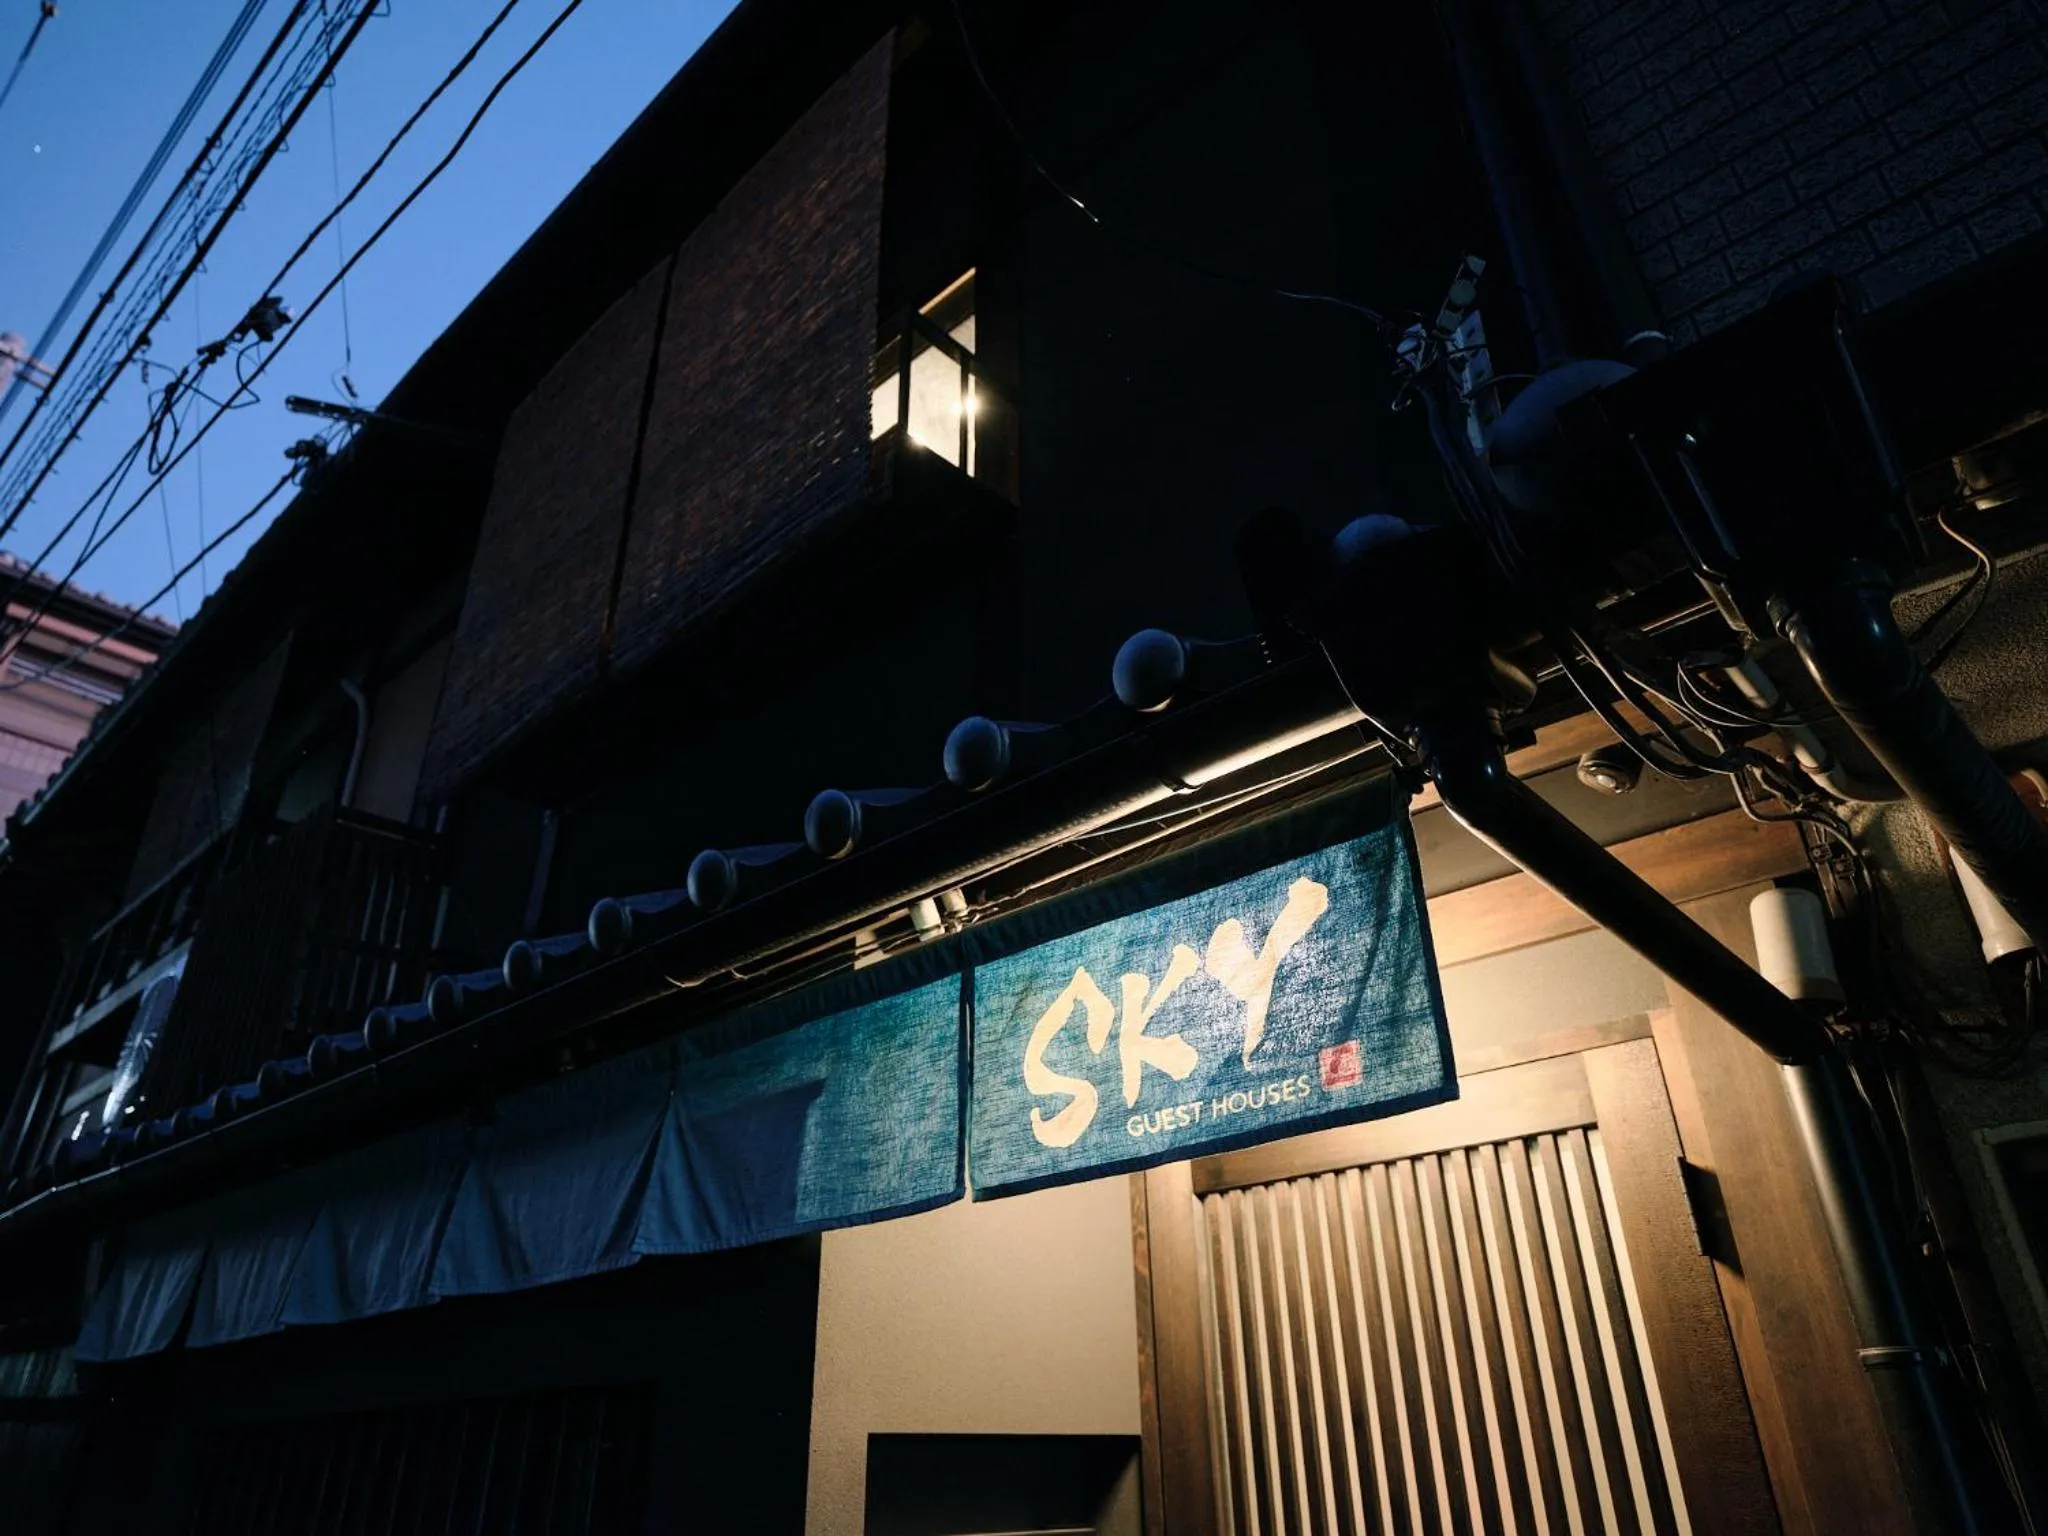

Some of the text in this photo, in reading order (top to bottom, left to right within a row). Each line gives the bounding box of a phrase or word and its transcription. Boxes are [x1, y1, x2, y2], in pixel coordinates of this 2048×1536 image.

[1023, 876, 1329, 1148] SKY
[1126, 1075, 1311, 1137] GUEST HOUSES
